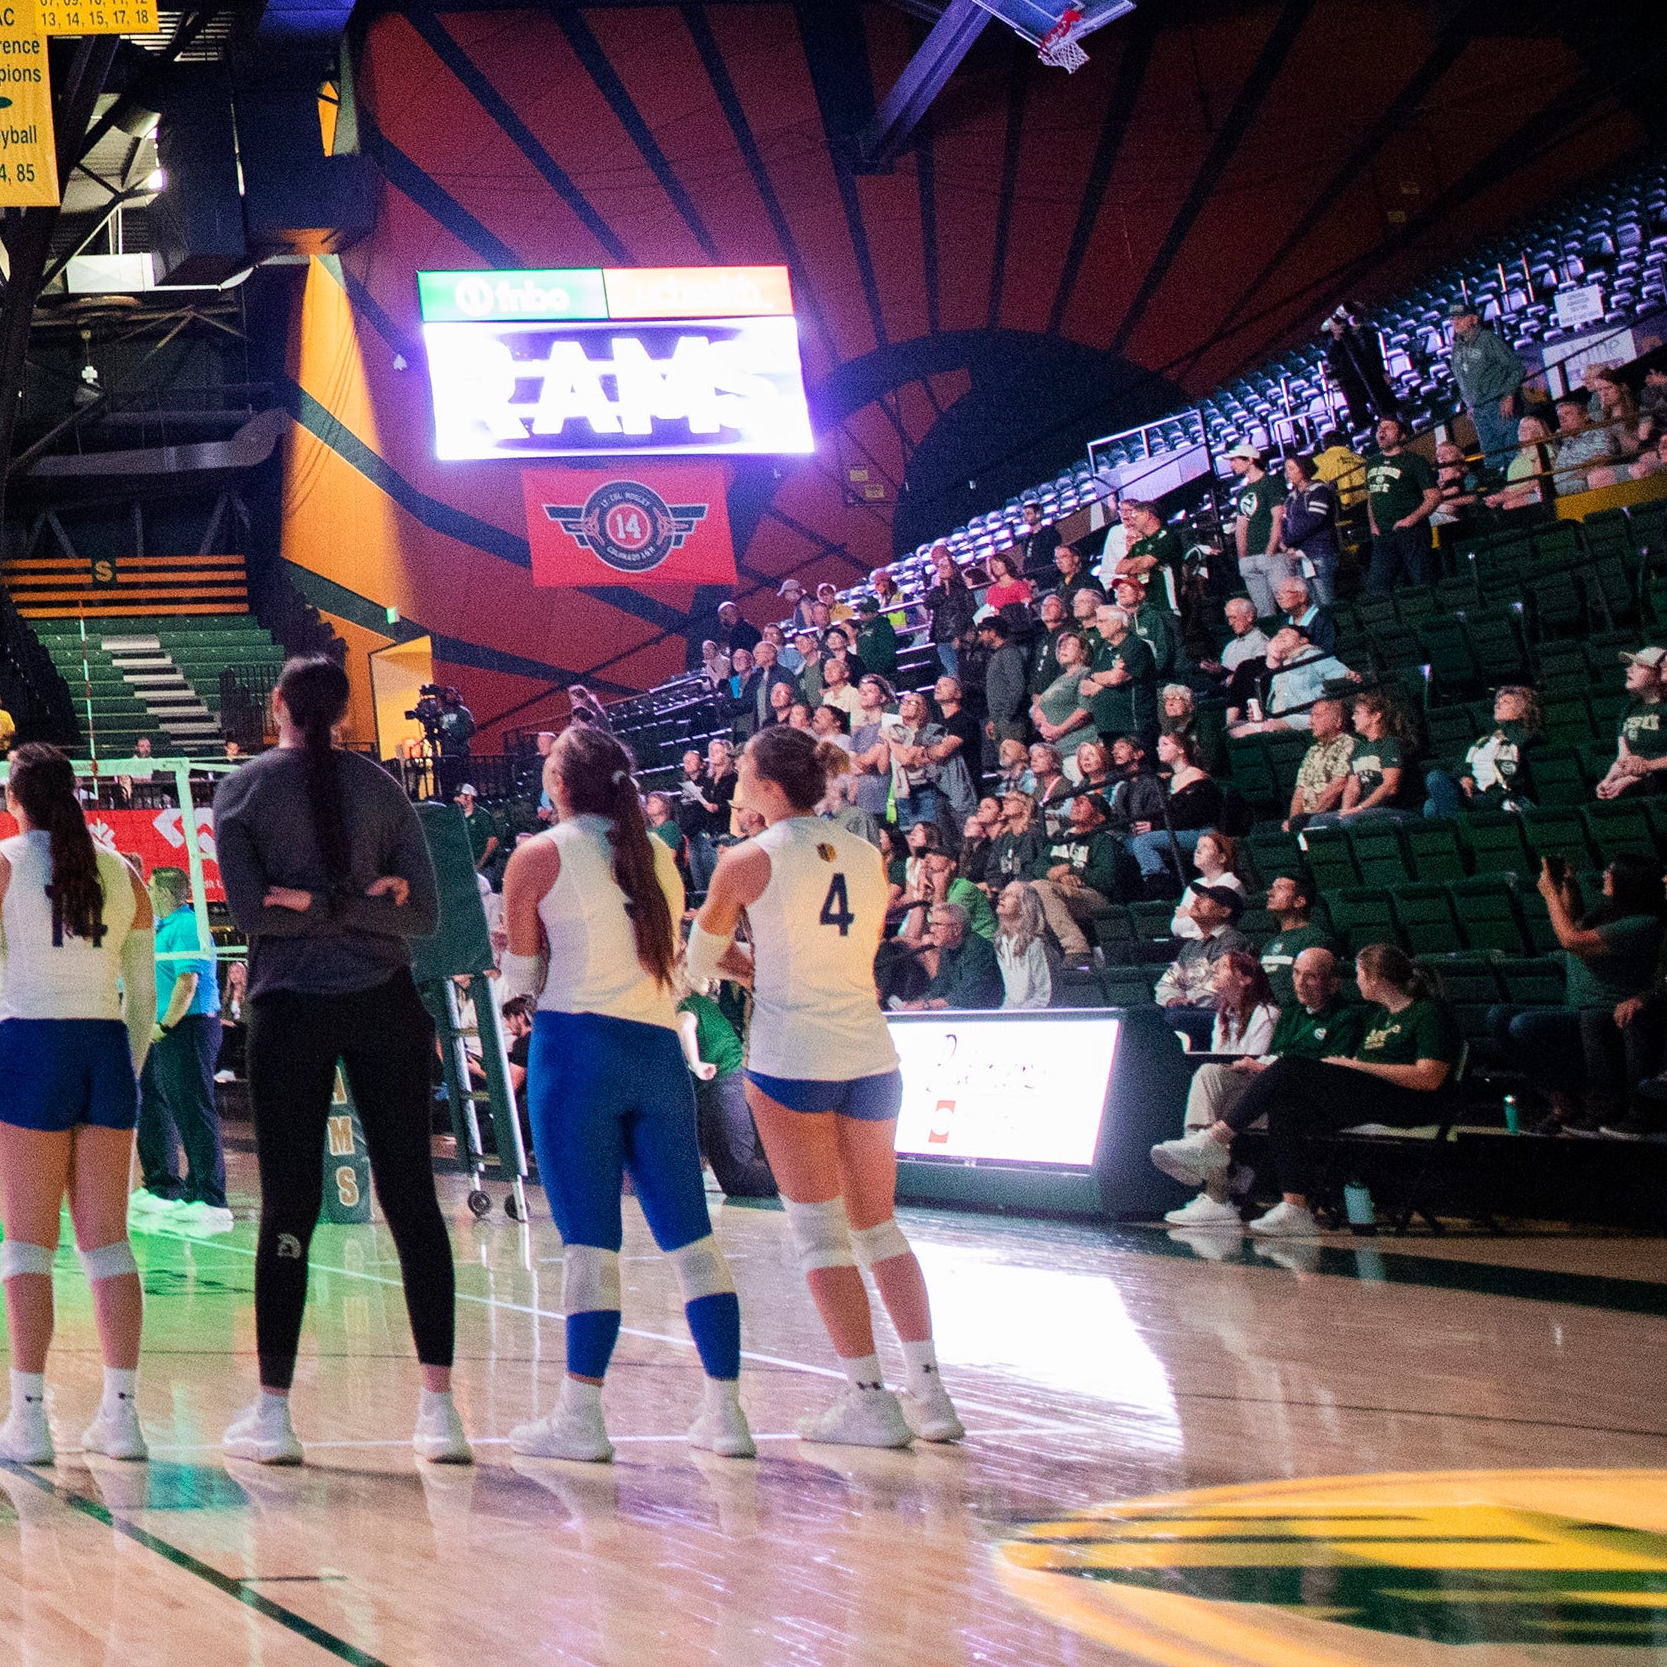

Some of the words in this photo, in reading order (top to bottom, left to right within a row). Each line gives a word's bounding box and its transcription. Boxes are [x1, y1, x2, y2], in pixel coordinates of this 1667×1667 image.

[16, 163, 35, 182] 85
[462, 335, 779, 437] RAMS
[616, 513, 641, 539] 14
[95, 561, 113, 582] S
[820, 872, 855, 938] 4
